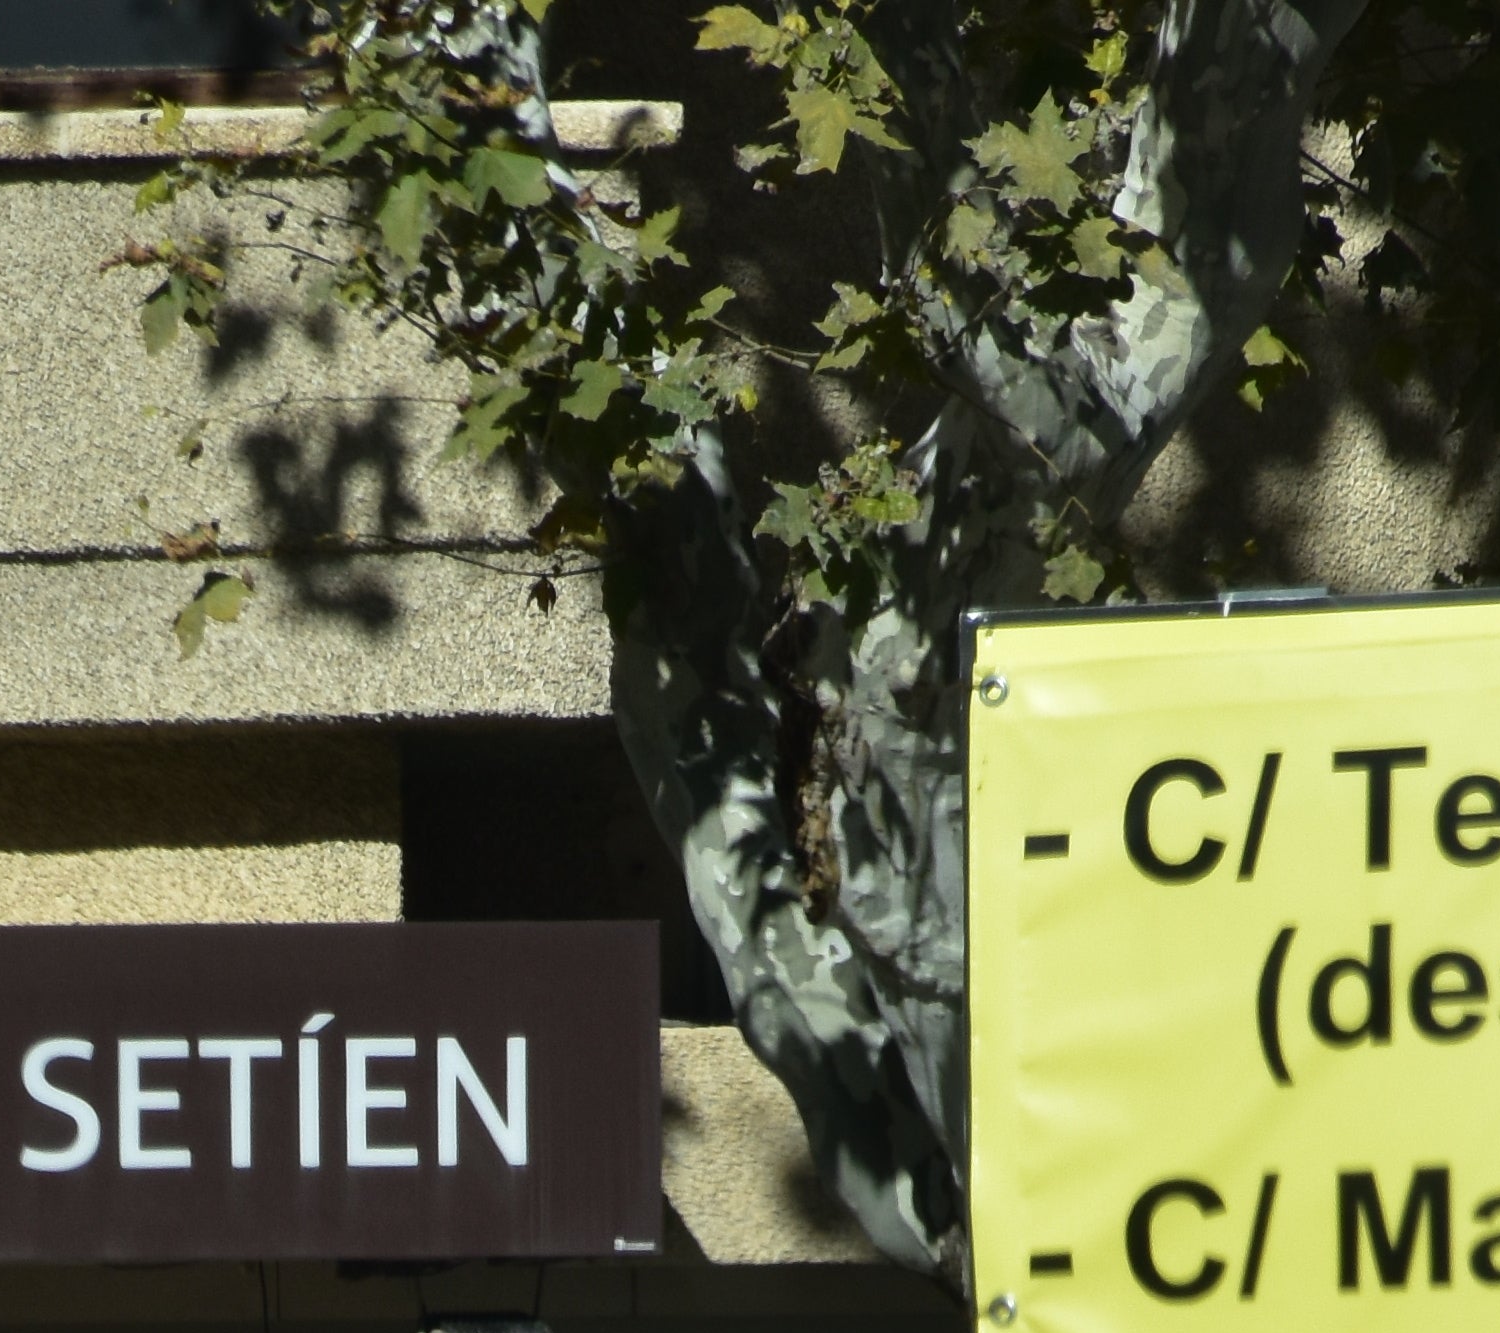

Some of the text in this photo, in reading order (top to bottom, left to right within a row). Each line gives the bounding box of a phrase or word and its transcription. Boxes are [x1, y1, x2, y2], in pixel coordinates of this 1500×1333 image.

[1120, 750, 1284, 885] C/
[17, 1011, 530, 1173] SETÍEN
[1123, 1172, 1281, 1303] C/
